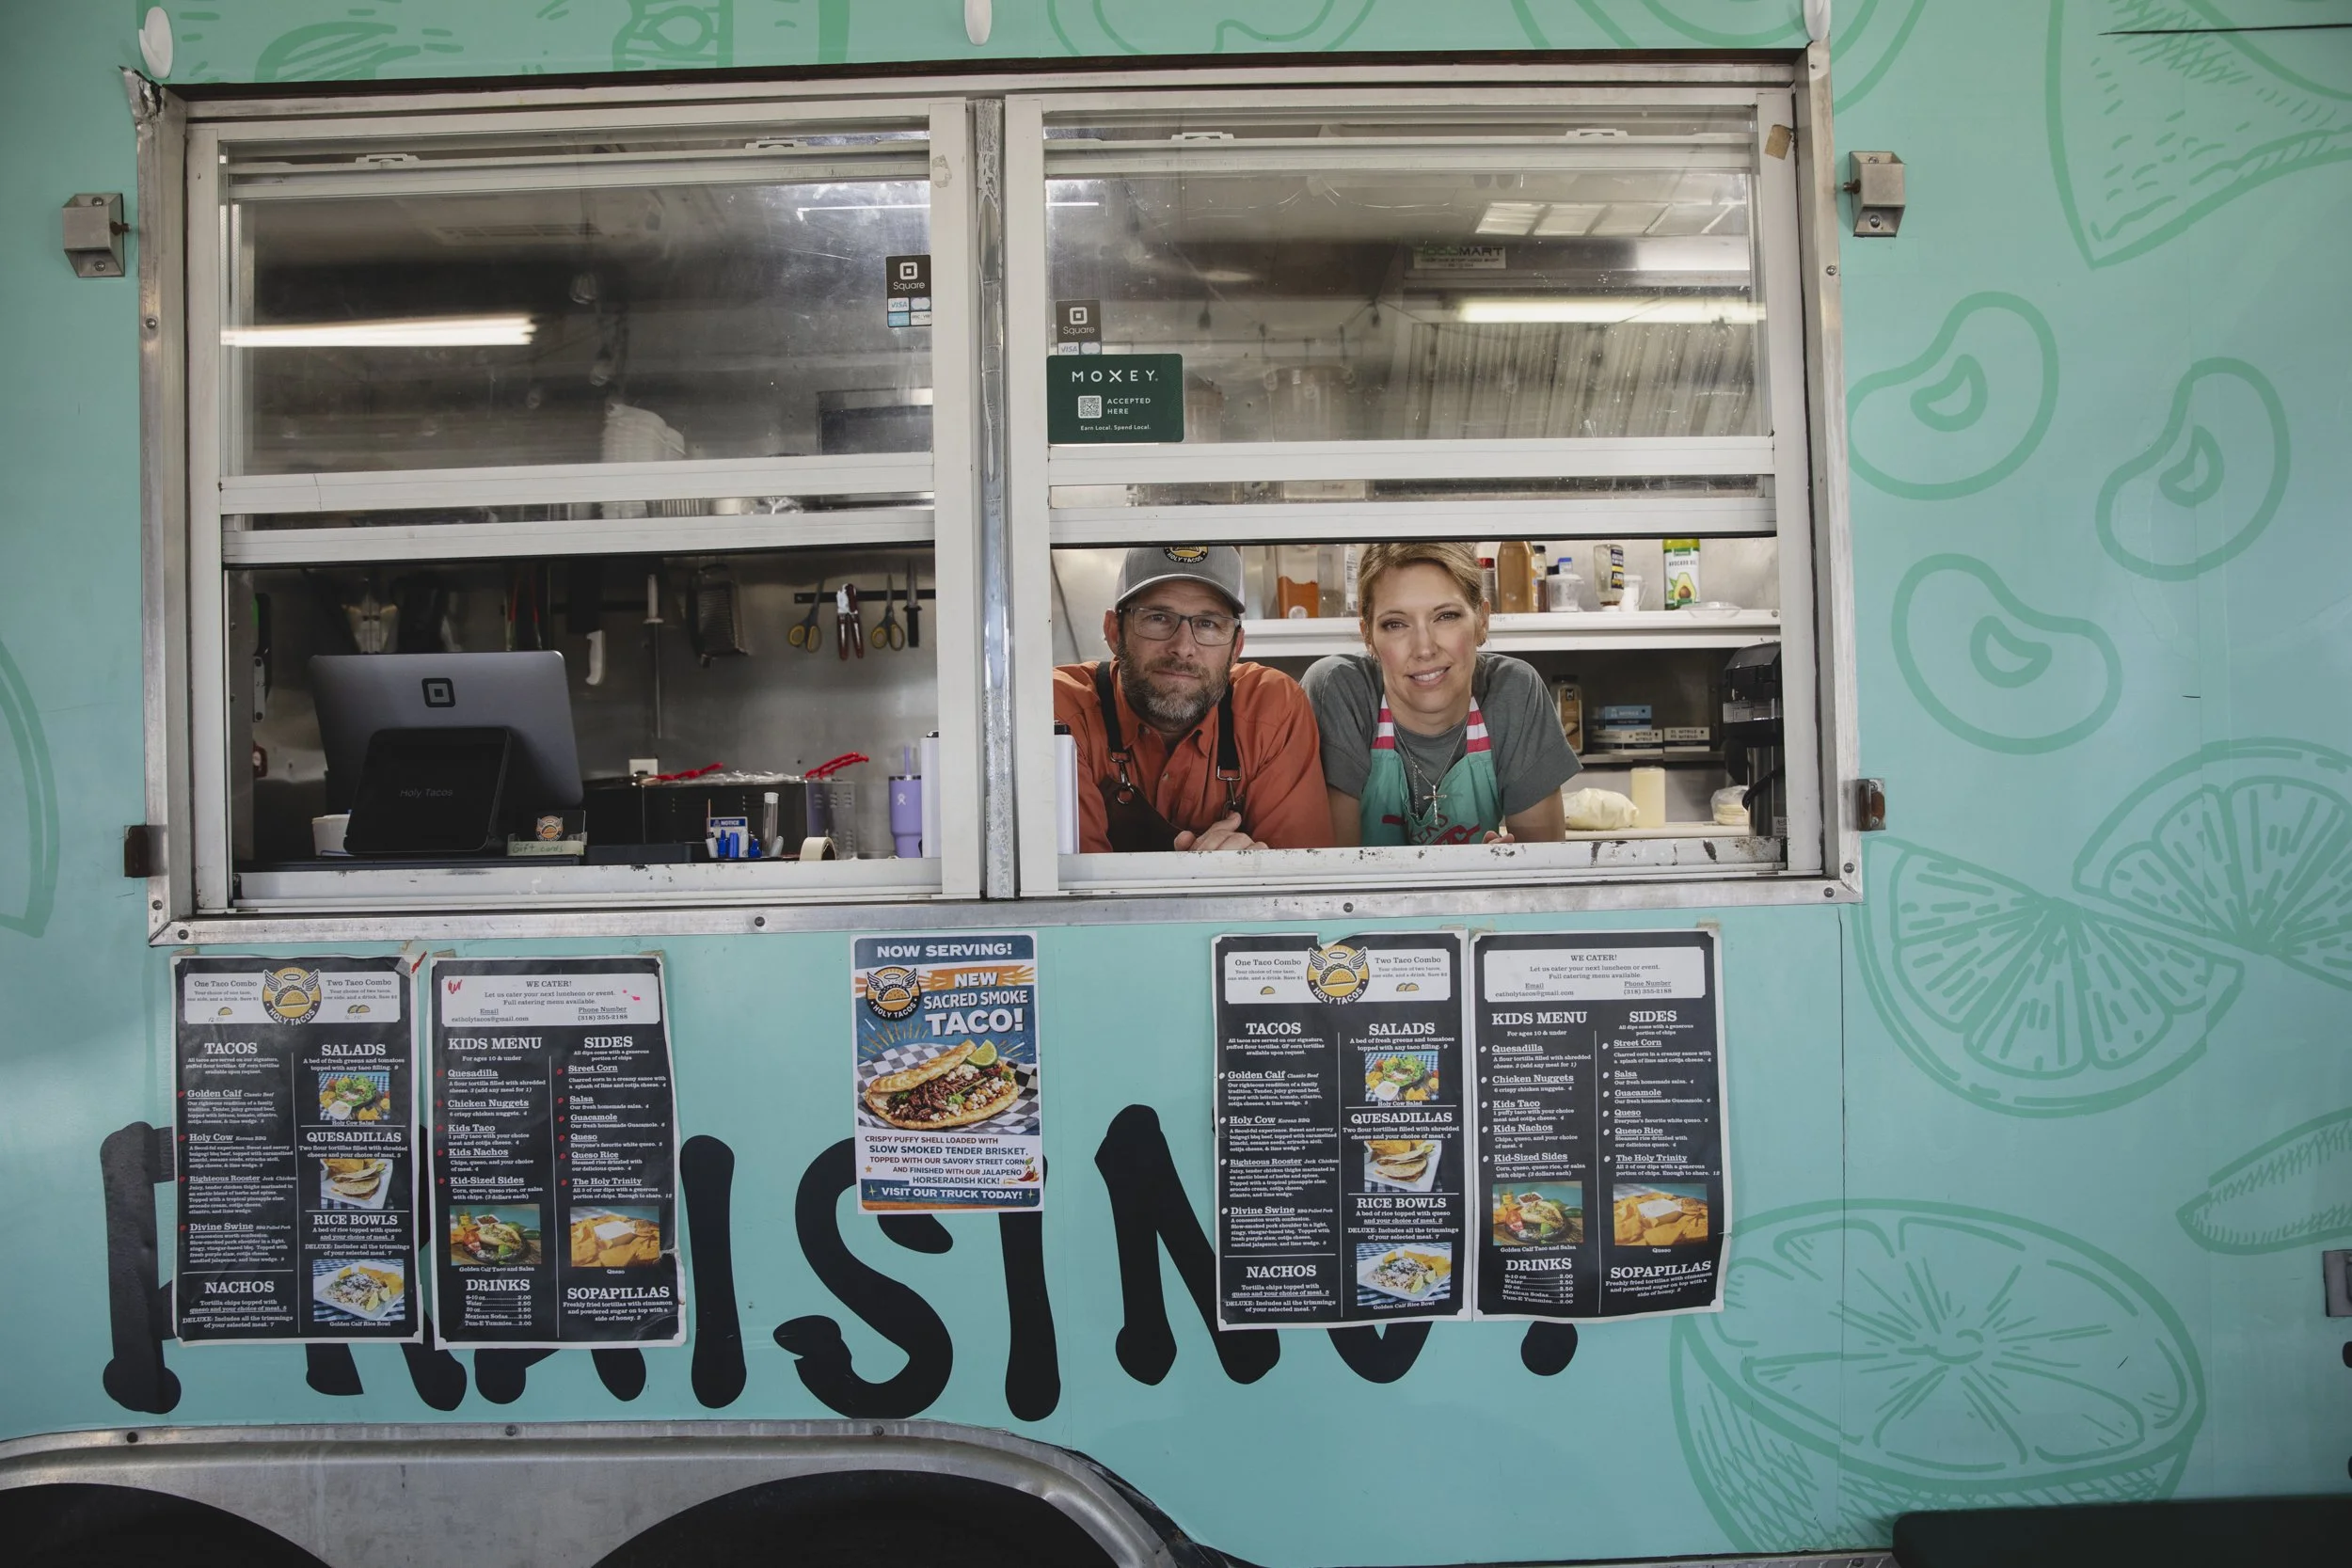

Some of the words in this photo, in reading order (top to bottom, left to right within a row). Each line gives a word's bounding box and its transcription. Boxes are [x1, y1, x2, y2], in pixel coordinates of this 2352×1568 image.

[894, 281, 925, 291] Square
[1063, 325, 1095, 335] Square
[1168, 552, 1183, 562] HOLY
[401, 788, 421, 799] Holy
[425, 788, 453, 797] Tacos
[878, 945, 920, 958] NOW
[926, 943, 1012, 957] SERVING!
[955, 973, 997, 988] NEW
[924, 992, 977, 1009] SACRED
[980, 990, 1027, 1006] SMOKE
[1313, 987, 1335, 1005] HOLY
[1336, 988, 1363, 1006] TACOS
[873, 1005, 891, 1018] HOLY
[894, 1002, 916, 1019] TACOS
[1629, 1011, 1677, 1022] SIDES
[269, 1008, 289, 1024] HOLY
[290, 1008, 315, 1026] TACOS
[926, 1008, 1024, 1036] TACO!
[1492, 1013, 1533, 1024] KIDS
[1536, 1012, 1587, 1023] MENU
[1246, 1022, 1301, 1035] TACOS
[1369, 1022, 1435, 1035] SALADS
[204, 1042, 258, 1054] TACOS
[448, 1038, 488, 1050] KIDS
[491, 1037, 542, 1049] MENU
[584, 1037, 633, 1048] SIDES
[1492, 1044, 1543, 1053] Quesadilla
[322, 1044, 386, 1056] SALADS
[448, 1069, 499, 1078] Quesadilla
[1264, 1070, 1285, 1079] Calf
[1492, 1075, 1531, 1084] Chicken
[1534, 1074, 1574, 1084] Nuggets
[489, 1100, 529, 1108] Nuggets
[1230, 1117, 1251, 1125] Holy
[1351, 1113, 1453, 1123] QUESADILLAS
[307, 1132, 401, 1143] QUESADILLAS
[1494, 1153, 1539, 1162] Kid-Sized
[1634, 1154, 1653, 1163] Holy
[1655, 1154, 1687, 1163] Trinity
[882, 1187, 911, 1196] VISIT
[940, 1189, 978, 1198] TRUCK
[981, 1190, 1023, 1199] TODAY!
[1357, 1198, 1392, 1208] RICE
[1395, 1198, 1446, 1208] BOWLS
[1231, 1207, 1263, 1215] Divine
[313, 1215, 347, 1225] RICE
[351, 1215, 398, 1225] BOWLS
[1247, 1265, 1316, 1277] NACHOS
[1506, 1259, 1572, 1271] DRINKS
[1611, 1260, 1711, 1278] SOPAPILLAS
[205, 1281, 275, 1293] NACHOS
[466, 1279, 530, 1291] DRINKS
[567, 1287, 670, 1299] SOPAPILLAS
